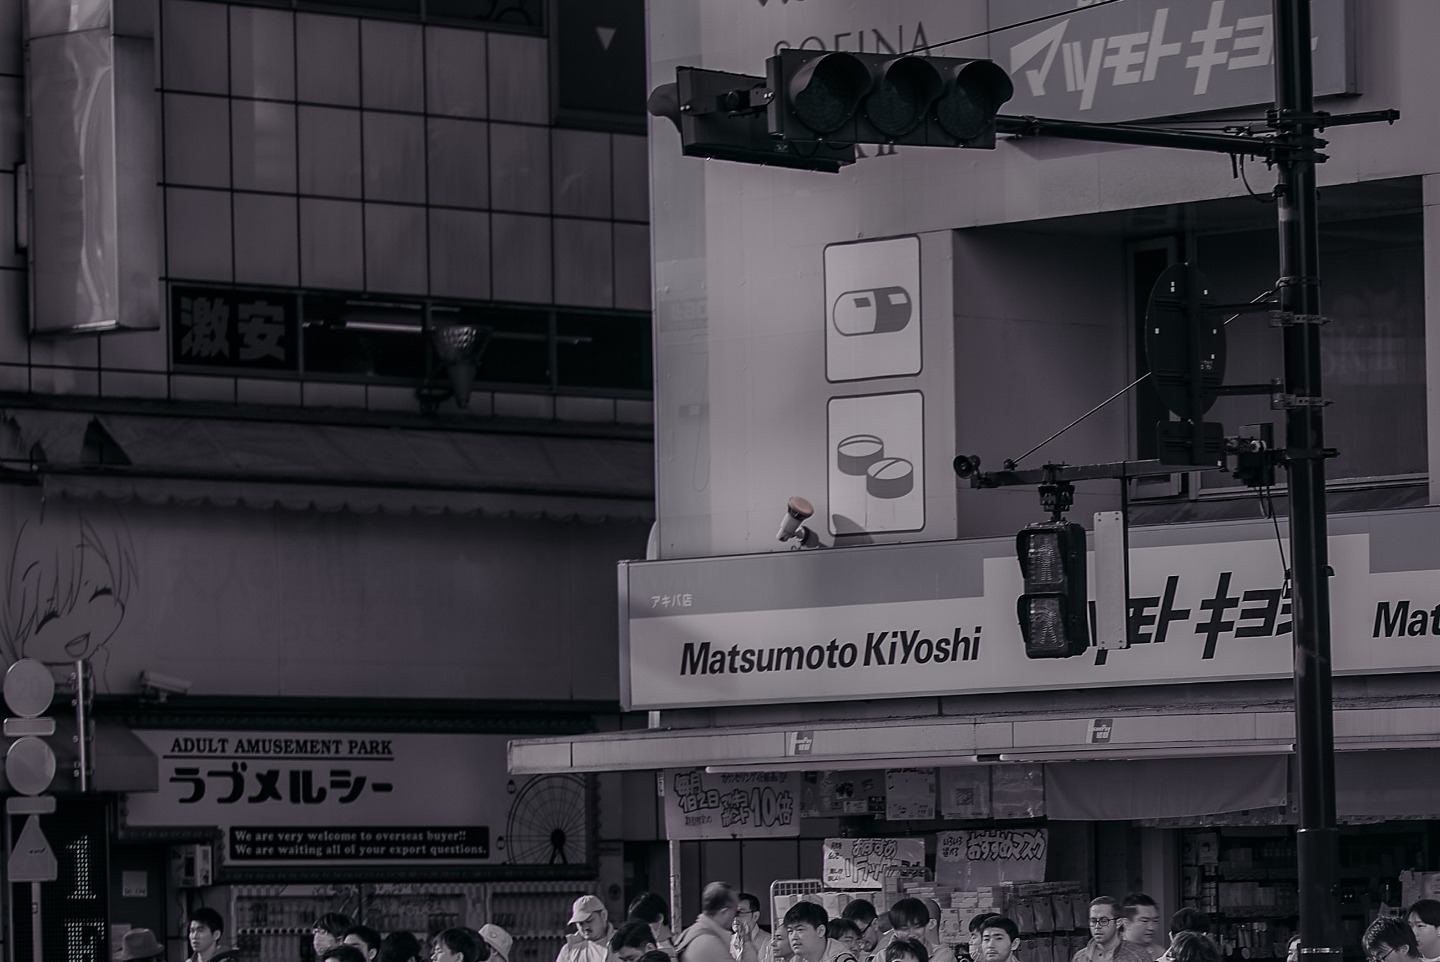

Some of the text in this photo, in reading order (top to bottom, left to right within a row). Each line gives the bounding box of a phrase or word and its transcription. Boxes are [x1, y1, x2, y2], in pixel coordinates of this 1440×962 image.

[180, 296, 286, 362] 激安
[651, 593, 693, 608] アキバ店
[680, 626, 982, 676] Matsumoto KiYoshi
[171, 738, 393, 755] ADULT AMUSEMENT PARK
[169, 761, 394, 804] ラブメルシー
[235, 830, 253, 841] We
[255, 832, 274, 841] are
[277, 832, 303, 844] very
[307, 830, 357, 841] welcome
[360, 831, 372, 841] to
[375, 832, 423, 841] overseas
[235, 844, 487, 858] We are waiting all of your export questions.
